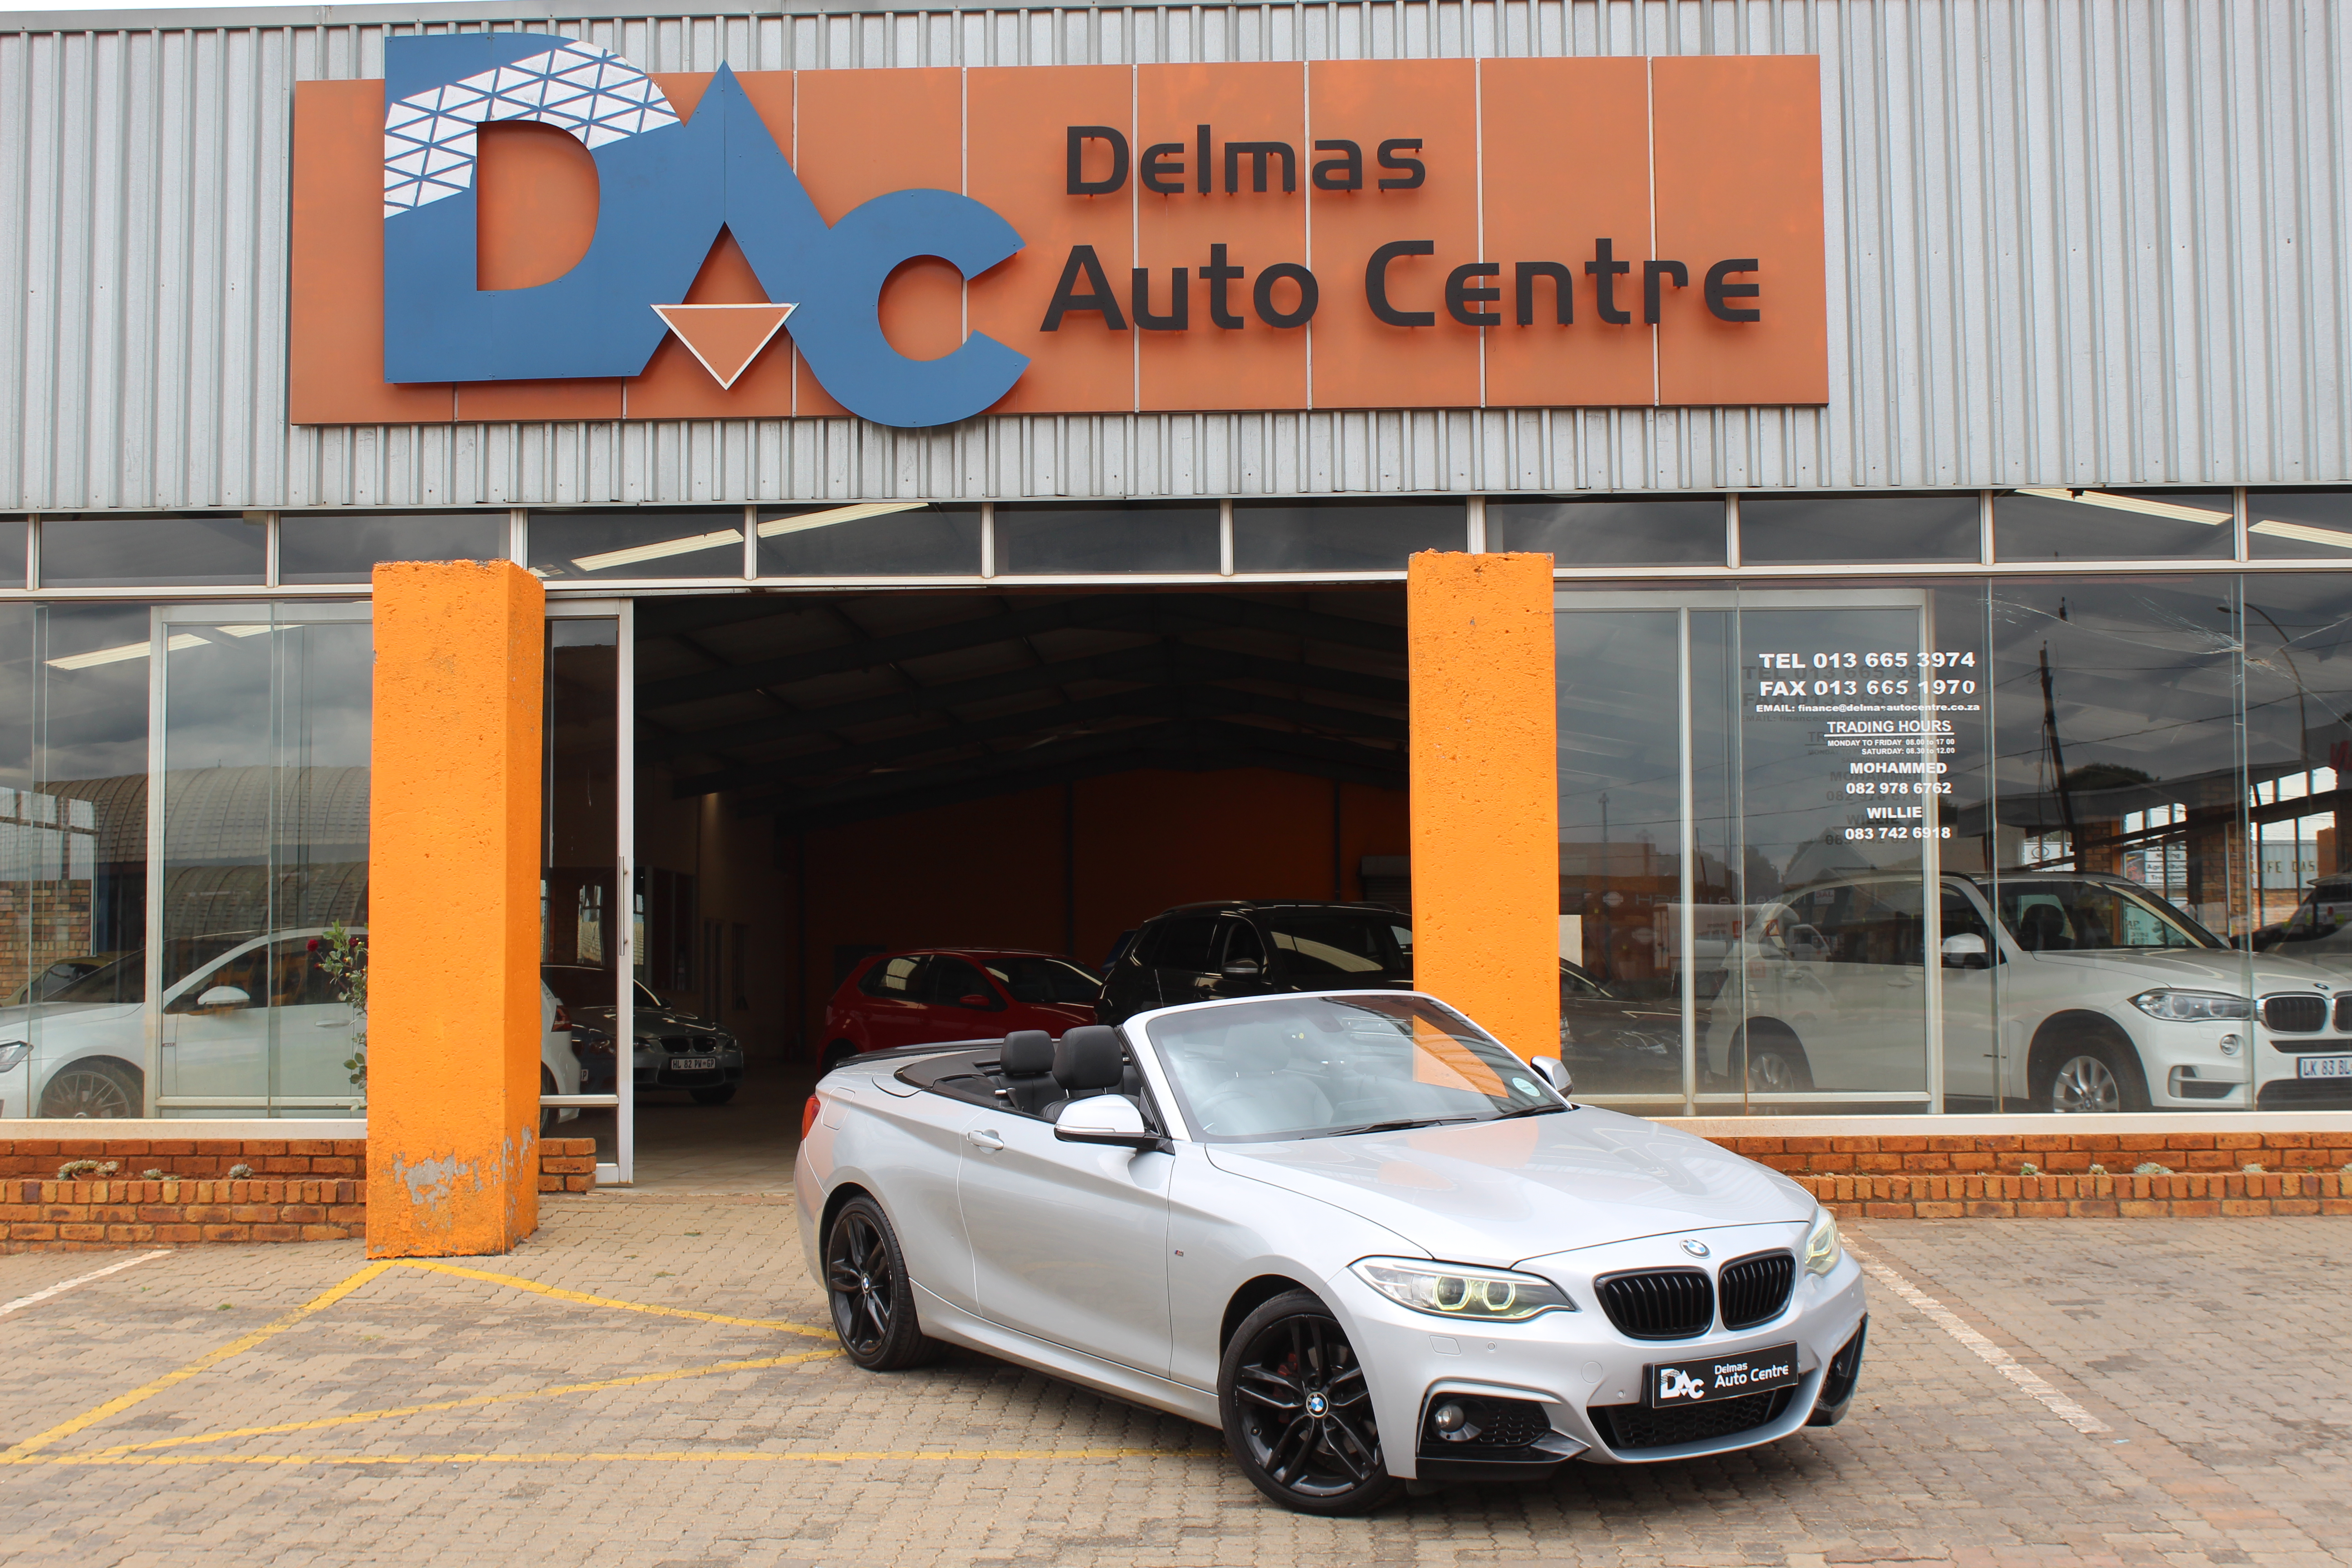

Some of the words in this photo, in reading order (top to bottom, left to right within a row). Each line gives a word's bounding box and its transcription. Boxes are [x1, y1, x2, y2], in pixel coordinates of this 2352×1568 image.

[1067, 124, 1426, 195] Delmas
[384, 32, 1031, 428] DAC
[1039, 244, 1319, 332] Auto
[1365, 238, 1760, 327] Centre
[1759, 653, 1806, 668] TEL
[1813, 653, 1857, 668] 013
[1865, 652, 1908, 668] 665
[1917, 652, 1975, 668] 3974
[1760, 681, 1807, 696] FAX
[1813, 681, 1857, 696] 013
[1866, 680, 1908, 695] 665
[1918, 680, 1976, 695] 1970
[1827, 720, 1894, 733] TRADING
[1898, 720, 1951, 732] HOURS
[1850, 762, 1947, 774] MOHAMMED
[1846, 782, 1875, 794] 082
[1879, 782, 1909, 794] 978
[1913, 782, 1952, 794] 6762
[1866, 806, 1922, 819] WILLIE
[1845, 828, 1875, 839] 083
[1878, 827, 1908, 839] 742
[1912, 827, 1951, 838] 6918
[673, 1059, 681, 1068] HL
[684, 1059, 692, 1068] 82
[694, 1059, 702, 1068] PW
[707, 1058, 714, 1068] GP
[2303, 1060, 2318, 1075] LK
[2322, 1060, 2334, 1075] 83
[1715, 1362, 1748, 1376] Delmas
[1714, 1372, 1747, 1389] Auto
[1750, 1364, 1789, 1382] Centre
